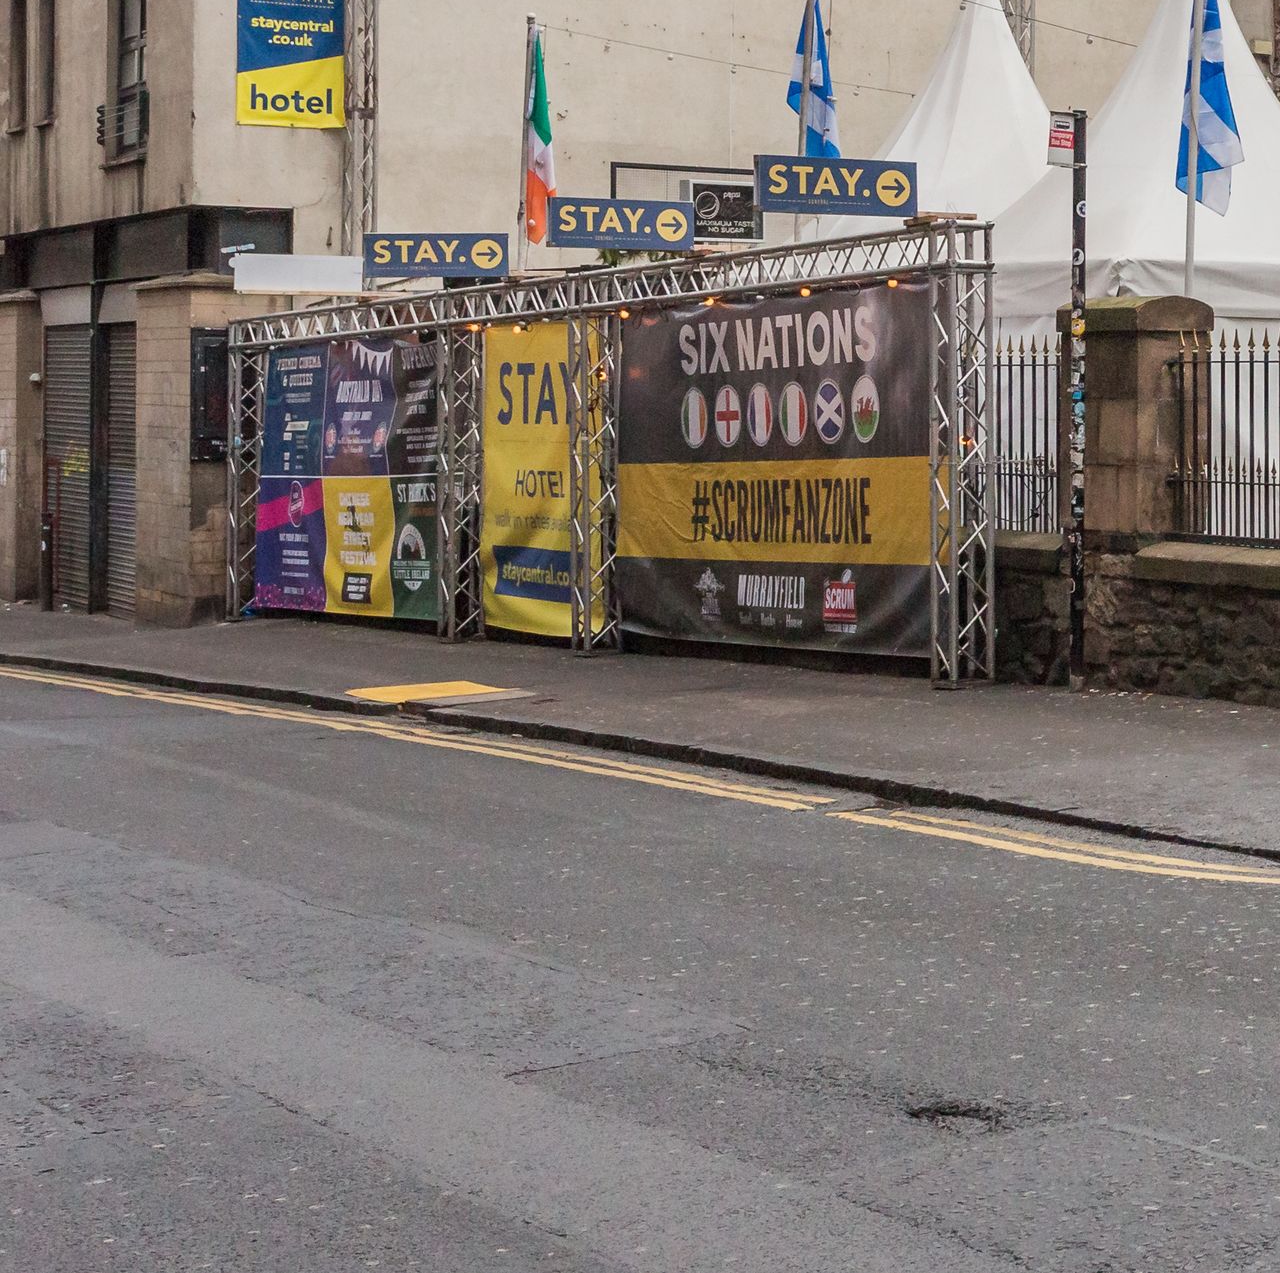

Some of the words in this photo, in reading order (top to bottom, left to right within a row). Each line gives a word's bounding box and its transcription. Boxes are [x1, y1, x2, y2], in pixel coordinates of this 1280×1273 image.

[251, 16, 334, 32] staycentral
[268, 34, 313, 47] .co.uk
[251, 83, 333, 115] hotel
[768, 164, 871, 197] STAY.
[723, 191, 741, 199] pepsi
[559, 204, 651, 235] STAY.
[696, 219, 732, 227] MAXIMUM
[733, 220, 754, 228] TASTE
[373, 239, 467, 264] STAY.
[679, 321, 730, 376] SIX
[735, 305, 877, 371] NATIONS
[497, 362, 582, 425] STAY
[515, 469, 565, 499] HOTEL
[692, 477, 872, 544] #SCRUMFANZONE
[340, 550, 377, 566] FESTIVAL
[502, 561, 584, 588] staycentral.co
[737, 574, 805, 609] MURRAYFIELD
[825, 588, 855, 610] SCRUM
